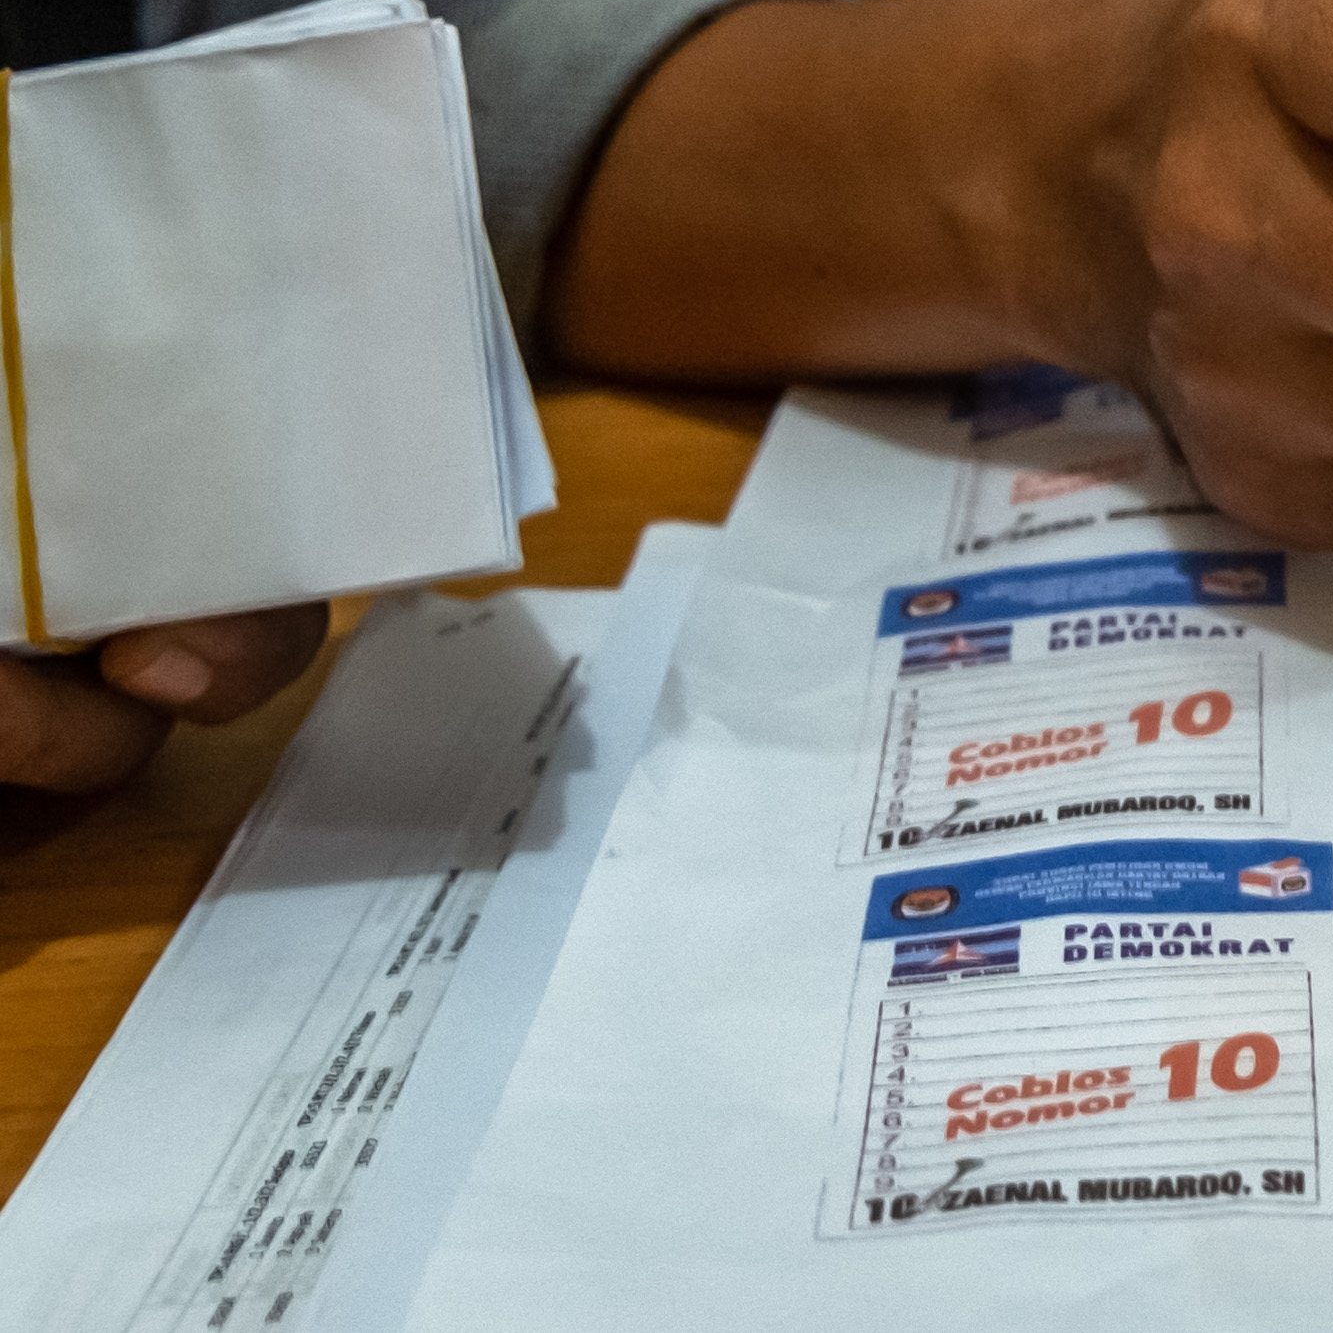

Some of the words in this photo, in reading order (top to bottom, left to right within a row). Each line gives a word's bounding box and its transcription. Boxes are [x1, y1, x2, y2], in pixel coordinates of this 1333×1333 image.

[1128, 690, 1233, 746] 10
[945, 741, 1109, 787] Nomor
[947, 722, 1107, 765] Coblos
[940, 809, 1049, 840] ZAENAL
[1213, 793, 1251, 811] SH
[1063, 922, 1213, 940] PARTAI
[1063, 938, 1294, 962] DEMOKRAT
[946, 1066, 1131, 1112] Coblos
[1159, 1032, 1280, 1101] 10
[944, 1090, 1136, 1140] Nomor
[940, 1174, 1068, 1211] ZAENAL
[1079, 1172, 1251, 1202] MUBAROQ,
[1262, 1170, 1305, 1194] SH
